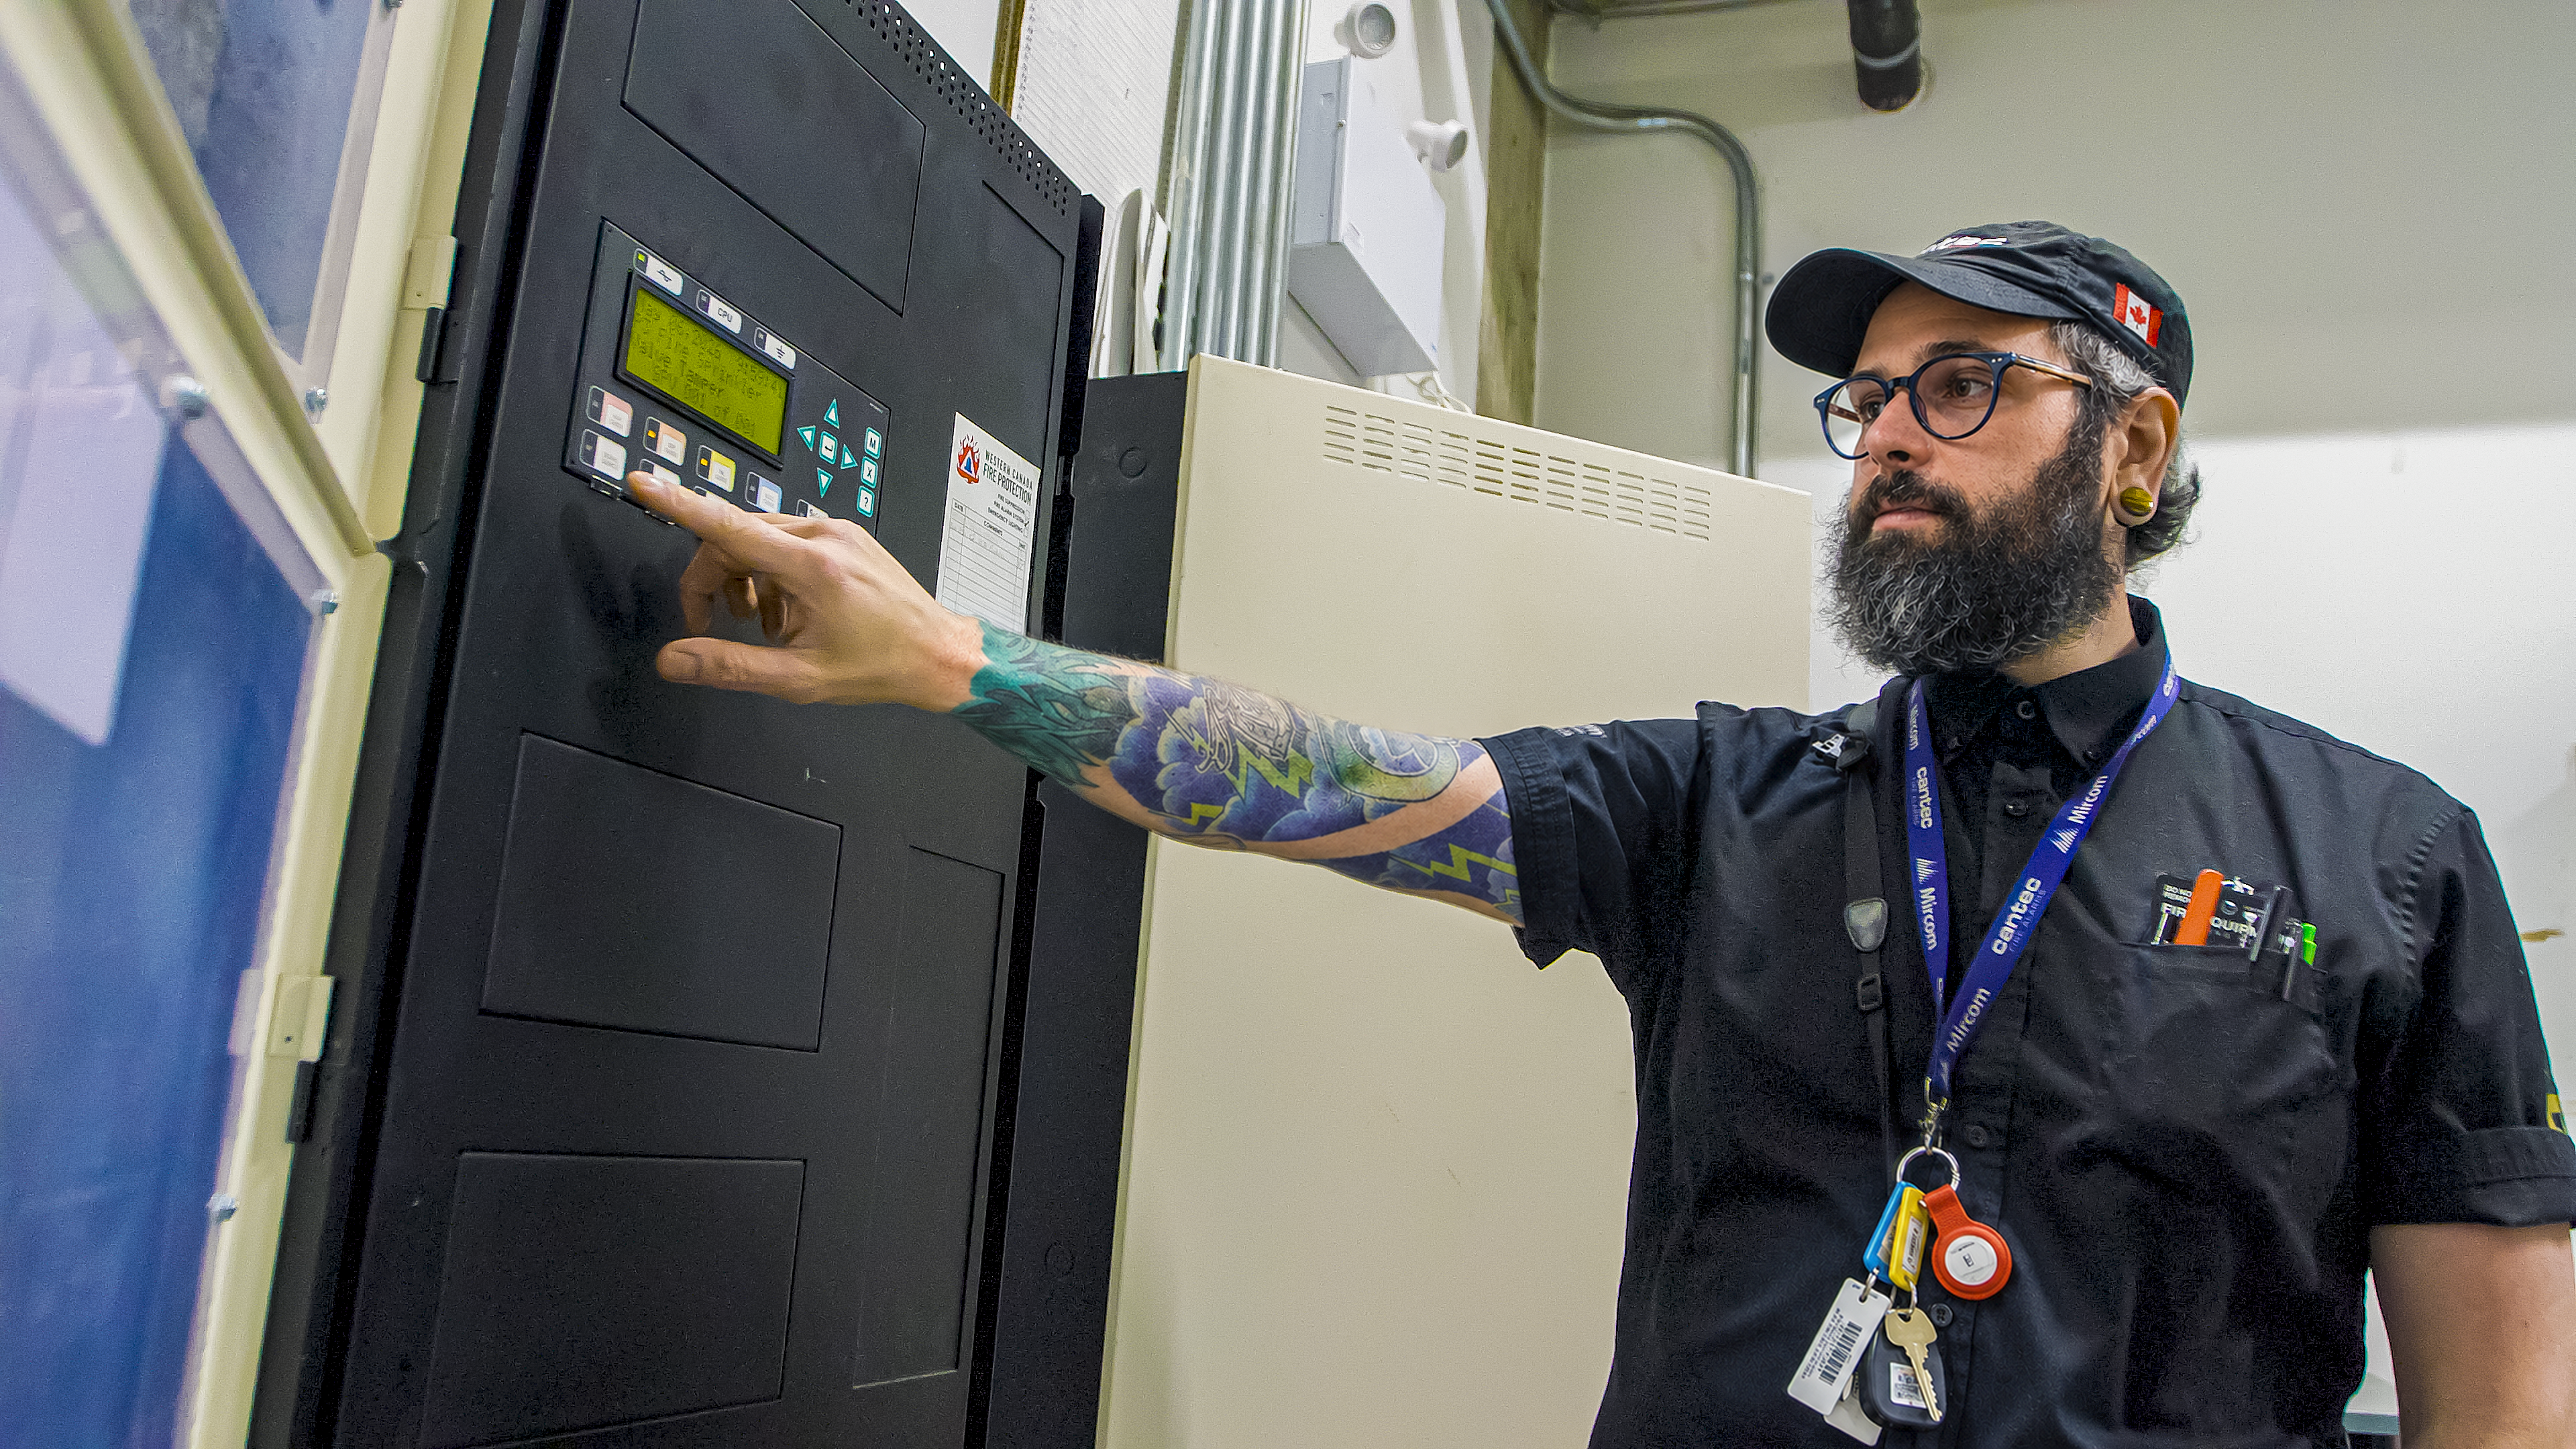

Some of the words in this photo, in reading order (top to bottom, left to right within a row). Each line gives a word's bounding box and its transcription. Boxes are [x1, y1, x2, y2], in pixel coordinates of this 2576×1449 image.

[718, 307, 733, 322] CPU
[983, 463, 996, 483] FIRE
[998, 473, 1032, 506] PROTECTION
[985, 449, 1010, 475] WESTERN
[1012, 469, 1033, 490] CANADA
[1917, 767, 1933, 829] cantec
[2067, 775, 2108, 824] Mircom
[1919, 887, 1937, 951] Mircom
[1992, 877, 2041, 955] cantec
[2161, 902, 2187, 918] FIR
[1947, 987, 1991, 1053] Mircom
